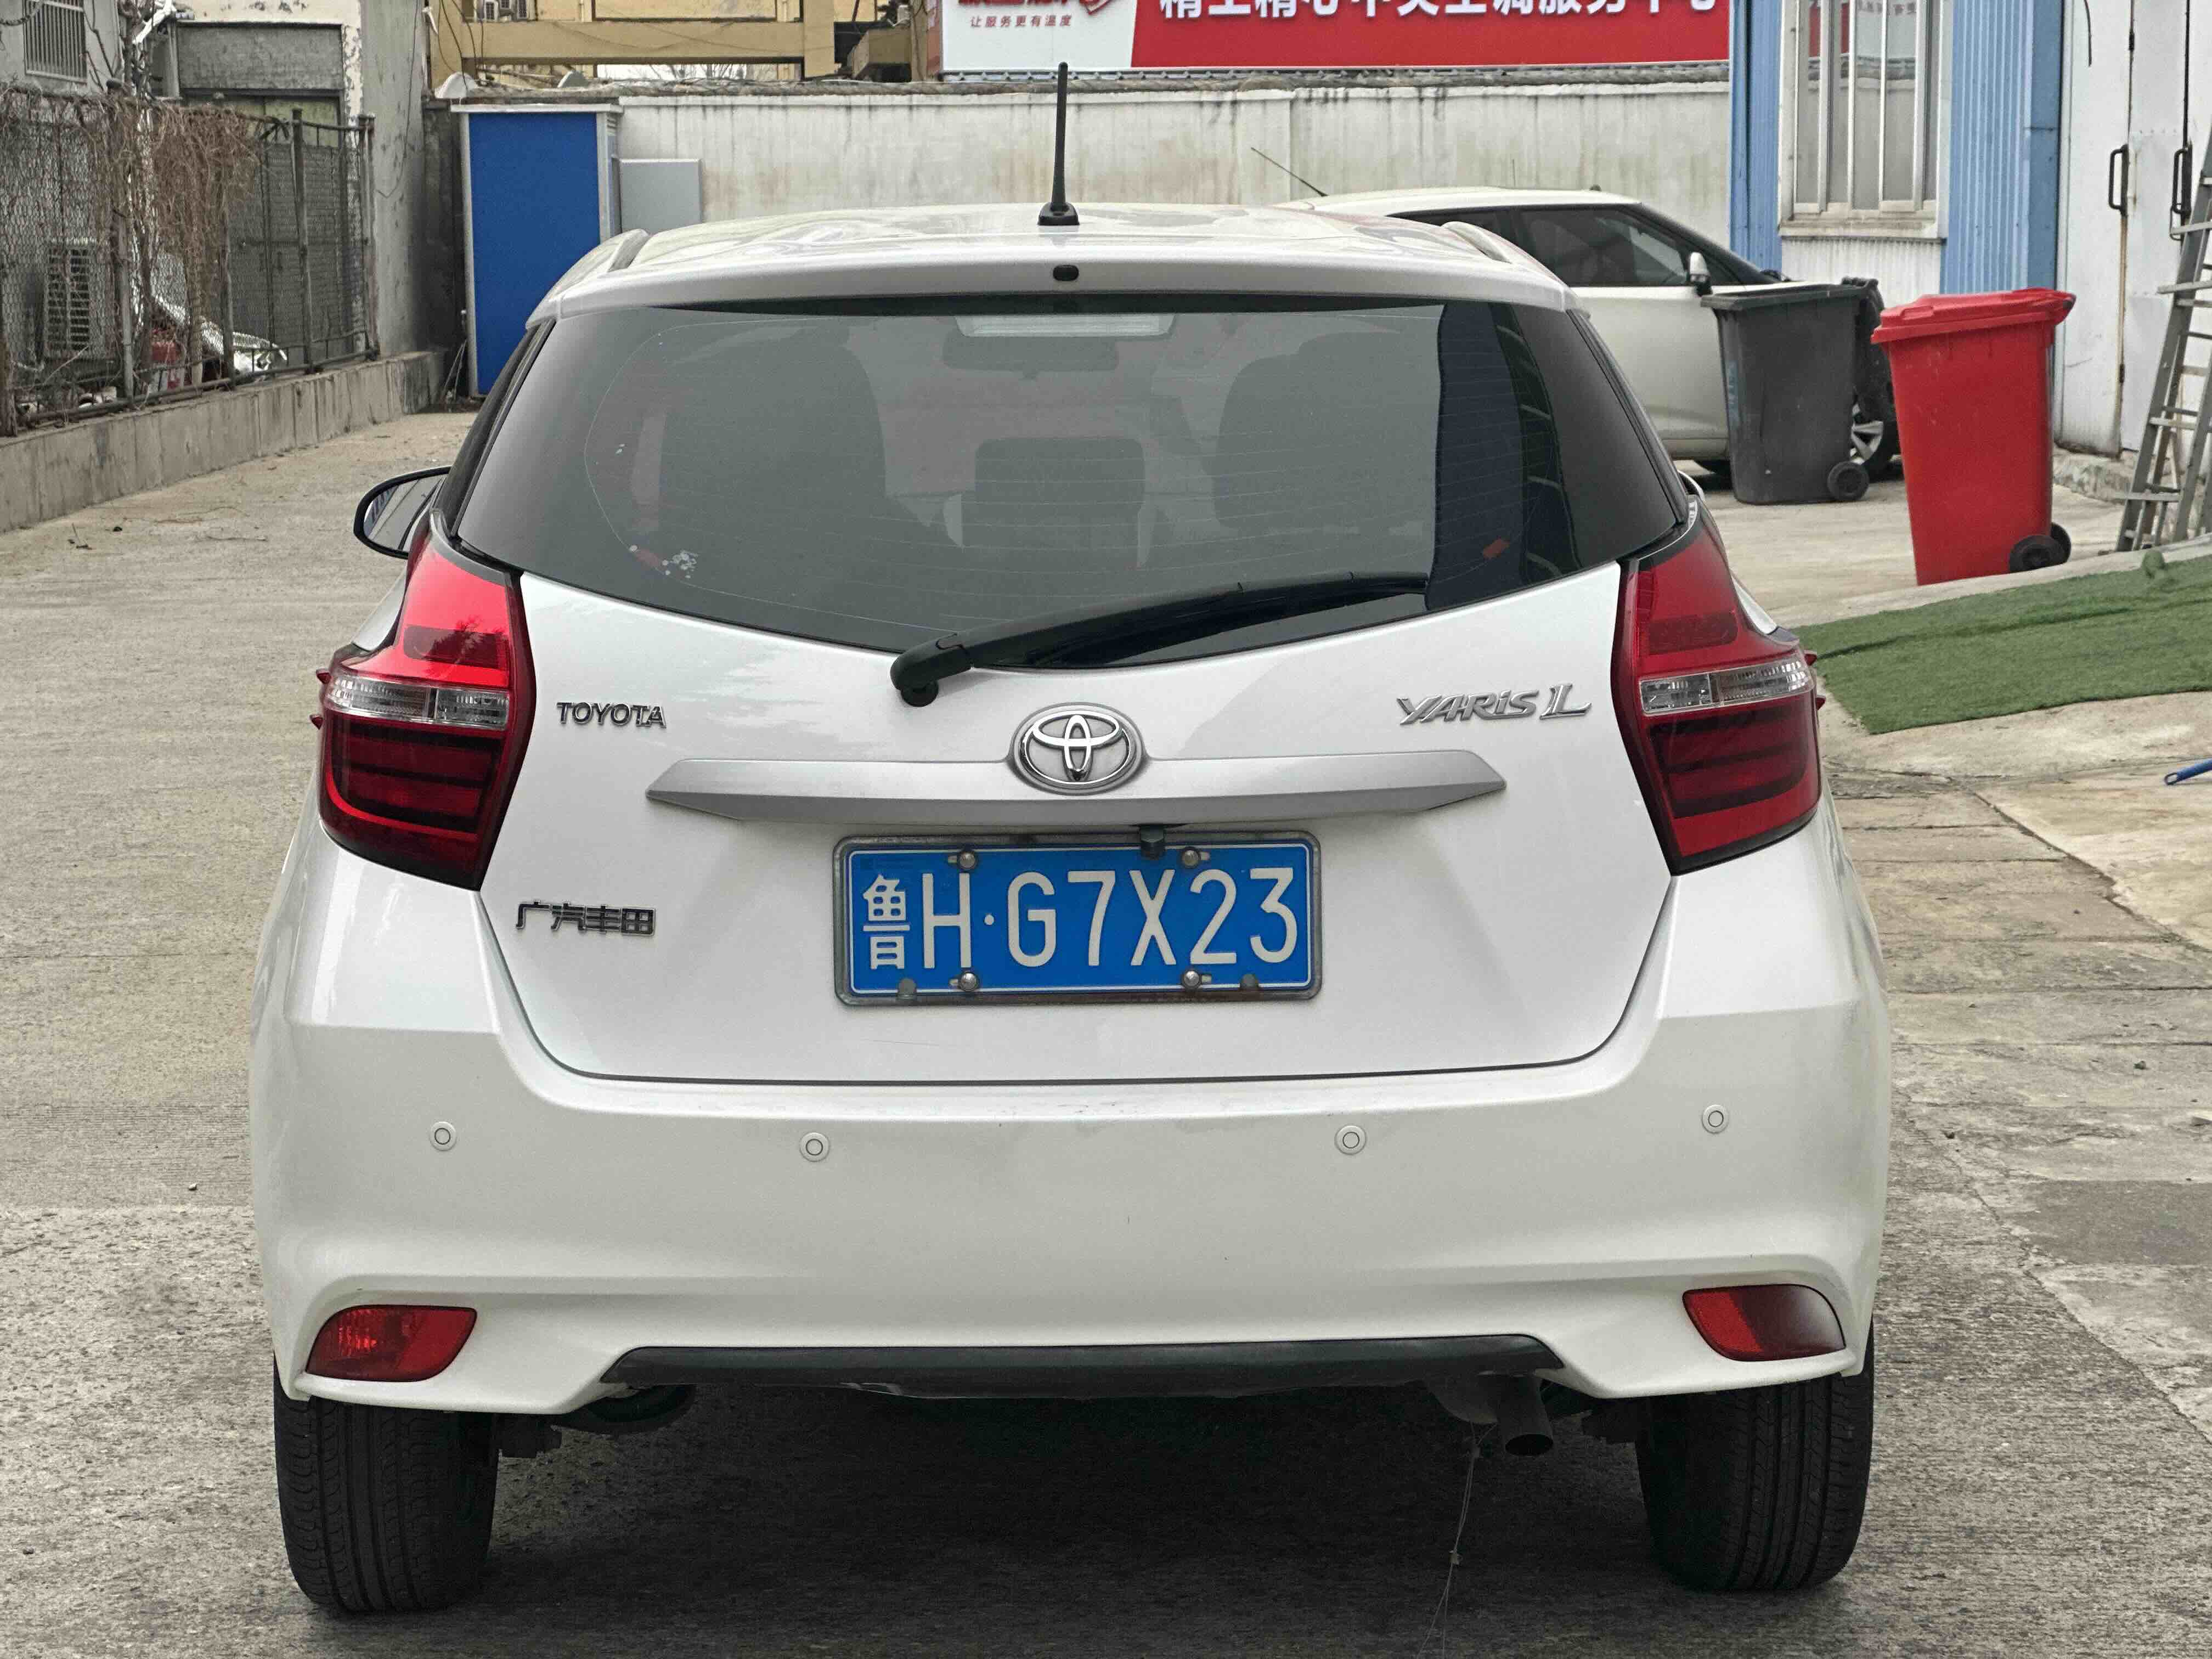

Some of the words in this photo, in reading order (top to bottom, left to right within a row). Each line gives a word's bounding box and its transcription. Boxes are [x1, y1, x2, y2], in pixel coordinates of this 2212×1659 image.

[970, 14, 1073, 28] 让服务更有温度
[557, 702, 667, 729] TOYOTA
[1540, 682, 1592, 720] L
[516, 900, 656, 936] 广汽丰田
[862, 867, 1297, 970] 鲁H·G7X23
